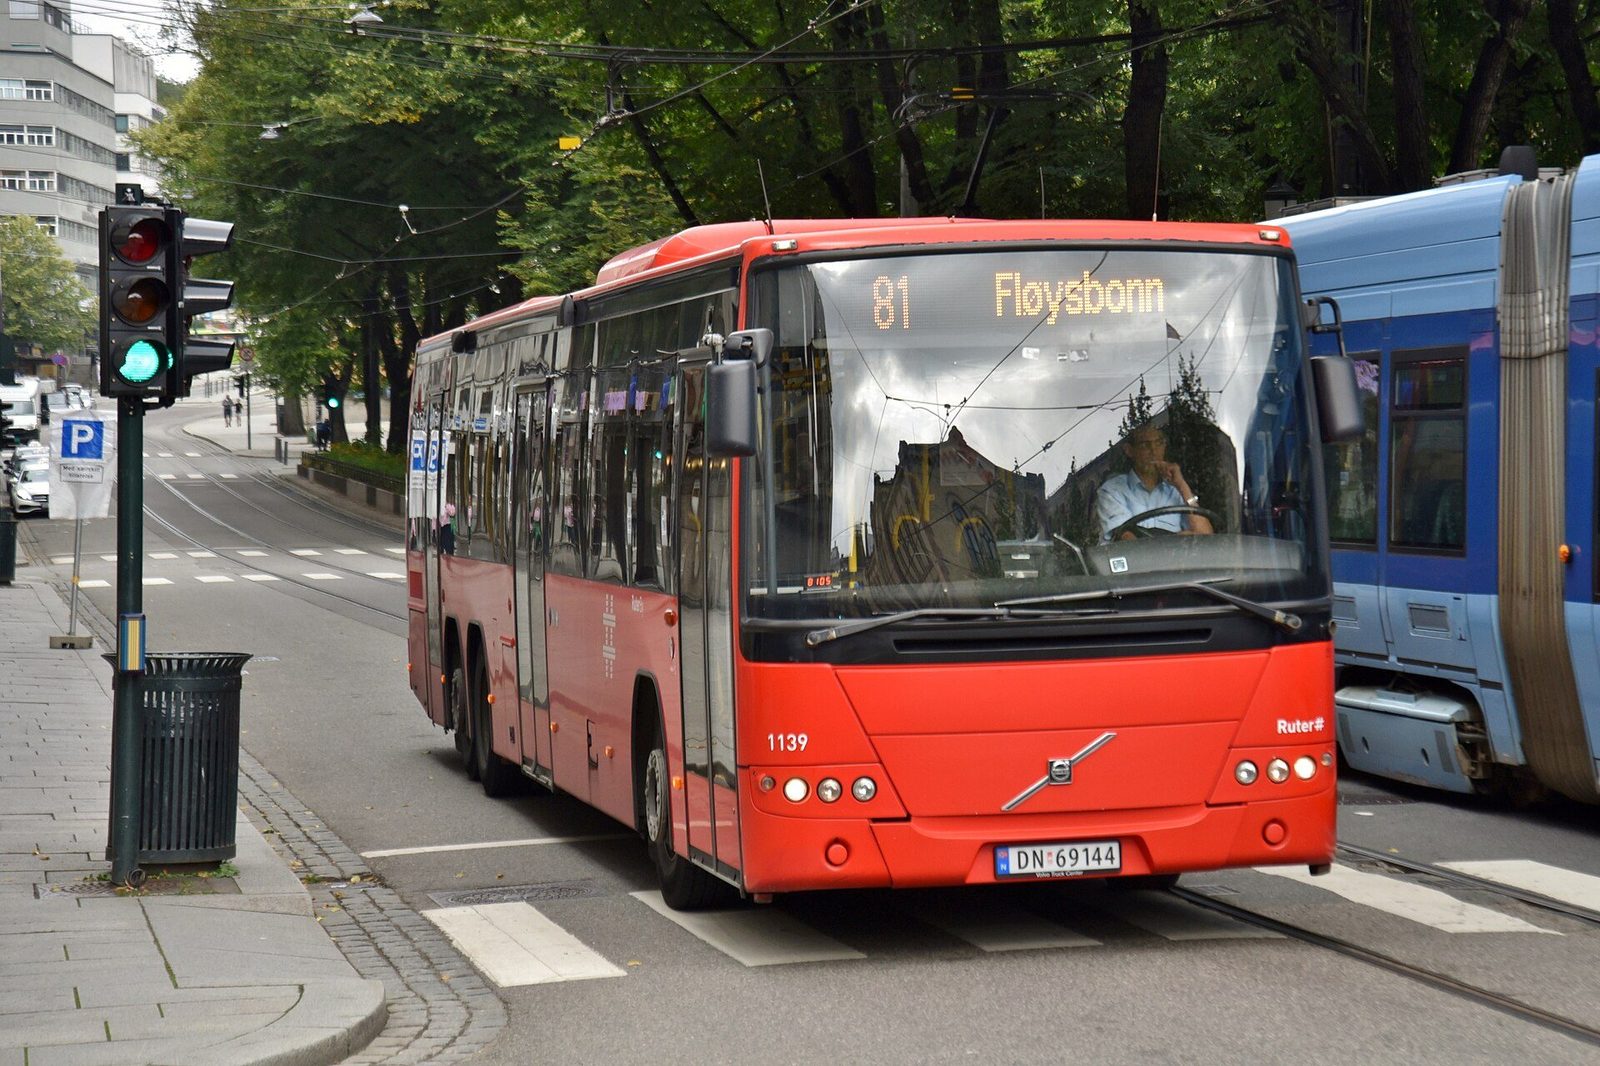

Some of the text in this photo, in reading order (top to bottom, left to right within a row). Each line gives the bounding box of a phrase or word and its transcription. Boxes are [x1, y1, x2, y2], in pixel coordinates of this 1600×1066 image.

[873, 270, 1164, 330] 81 Fløysbonn
[71, 424, 95, 454] P
[767, 733, 809, 752] 1139
[1017, 846, 1115, 870] DN 69144
